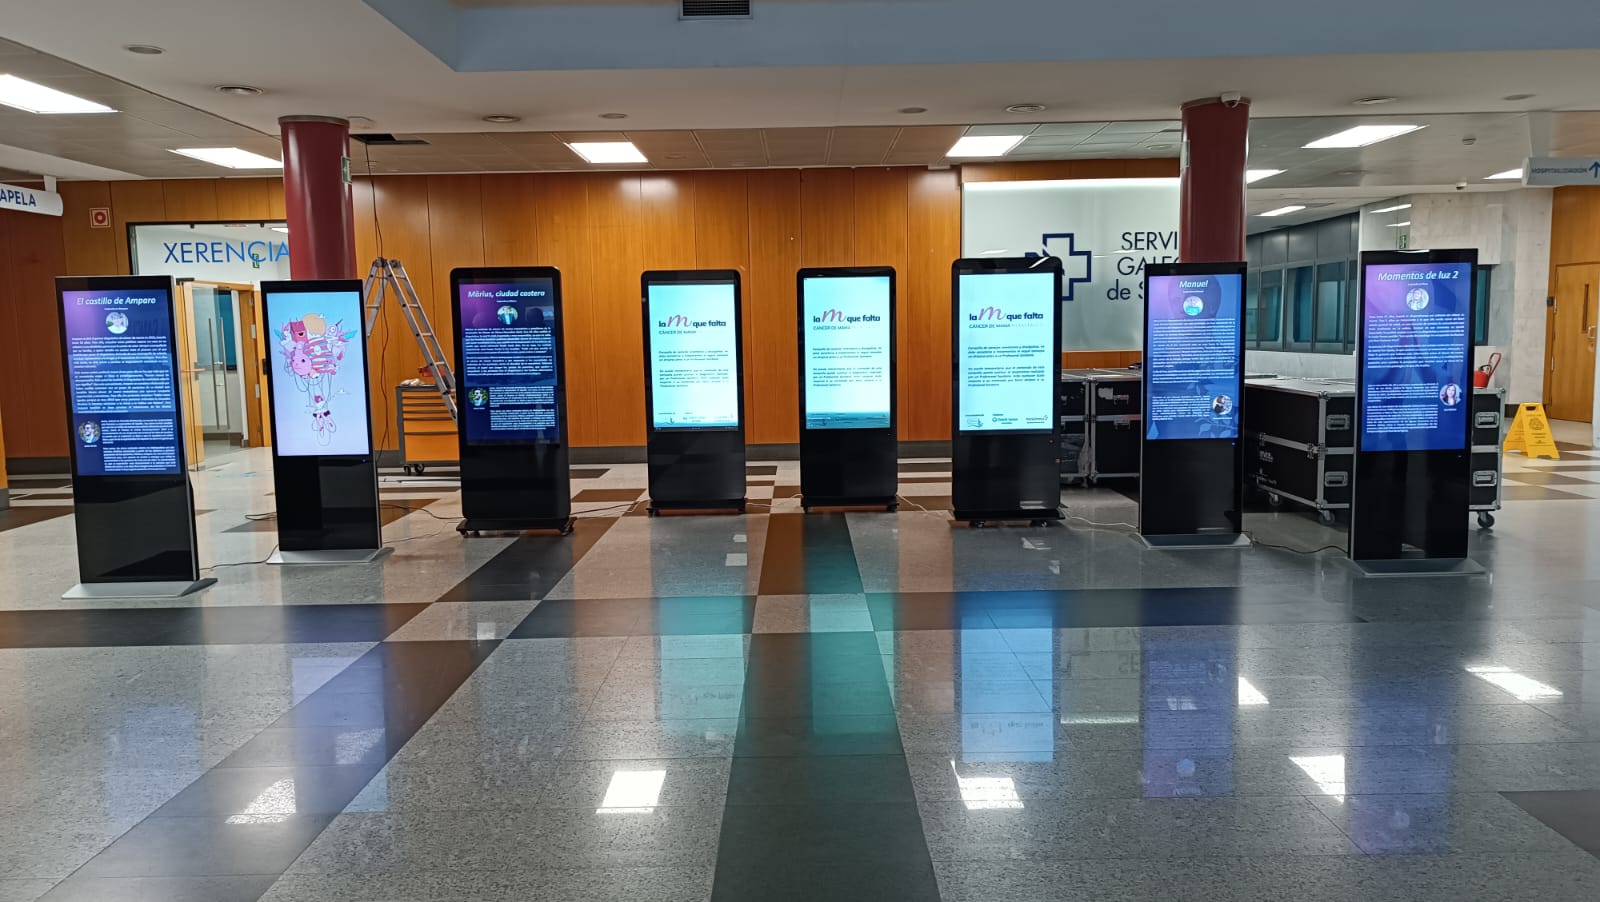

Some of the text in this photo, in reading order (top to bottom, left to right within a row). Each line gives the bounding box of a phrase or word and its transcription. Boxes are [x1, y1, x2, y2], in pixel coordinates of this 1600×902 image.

[0, 188, 37, 207] APELA
[1121, 231, 1178, 250] SERVI
[163, 241, 289, 263] XERENCIA
[1378, 270, 1459, 281] Momentos de luz 2
[1106, 278, 1131, 300] de
[1179, 280, 1209, 288] Manuel
[76, 296, 156, 306] El castillo de Amparo
[812, 315, 821, 323] la
[862, 314, 881, 322] falta
[969, 313, 978, 321] la
[1006, 314, 1022, 322] que
[1023, 312, 1044, 320] falta
[692, 320, 707, 328] que
